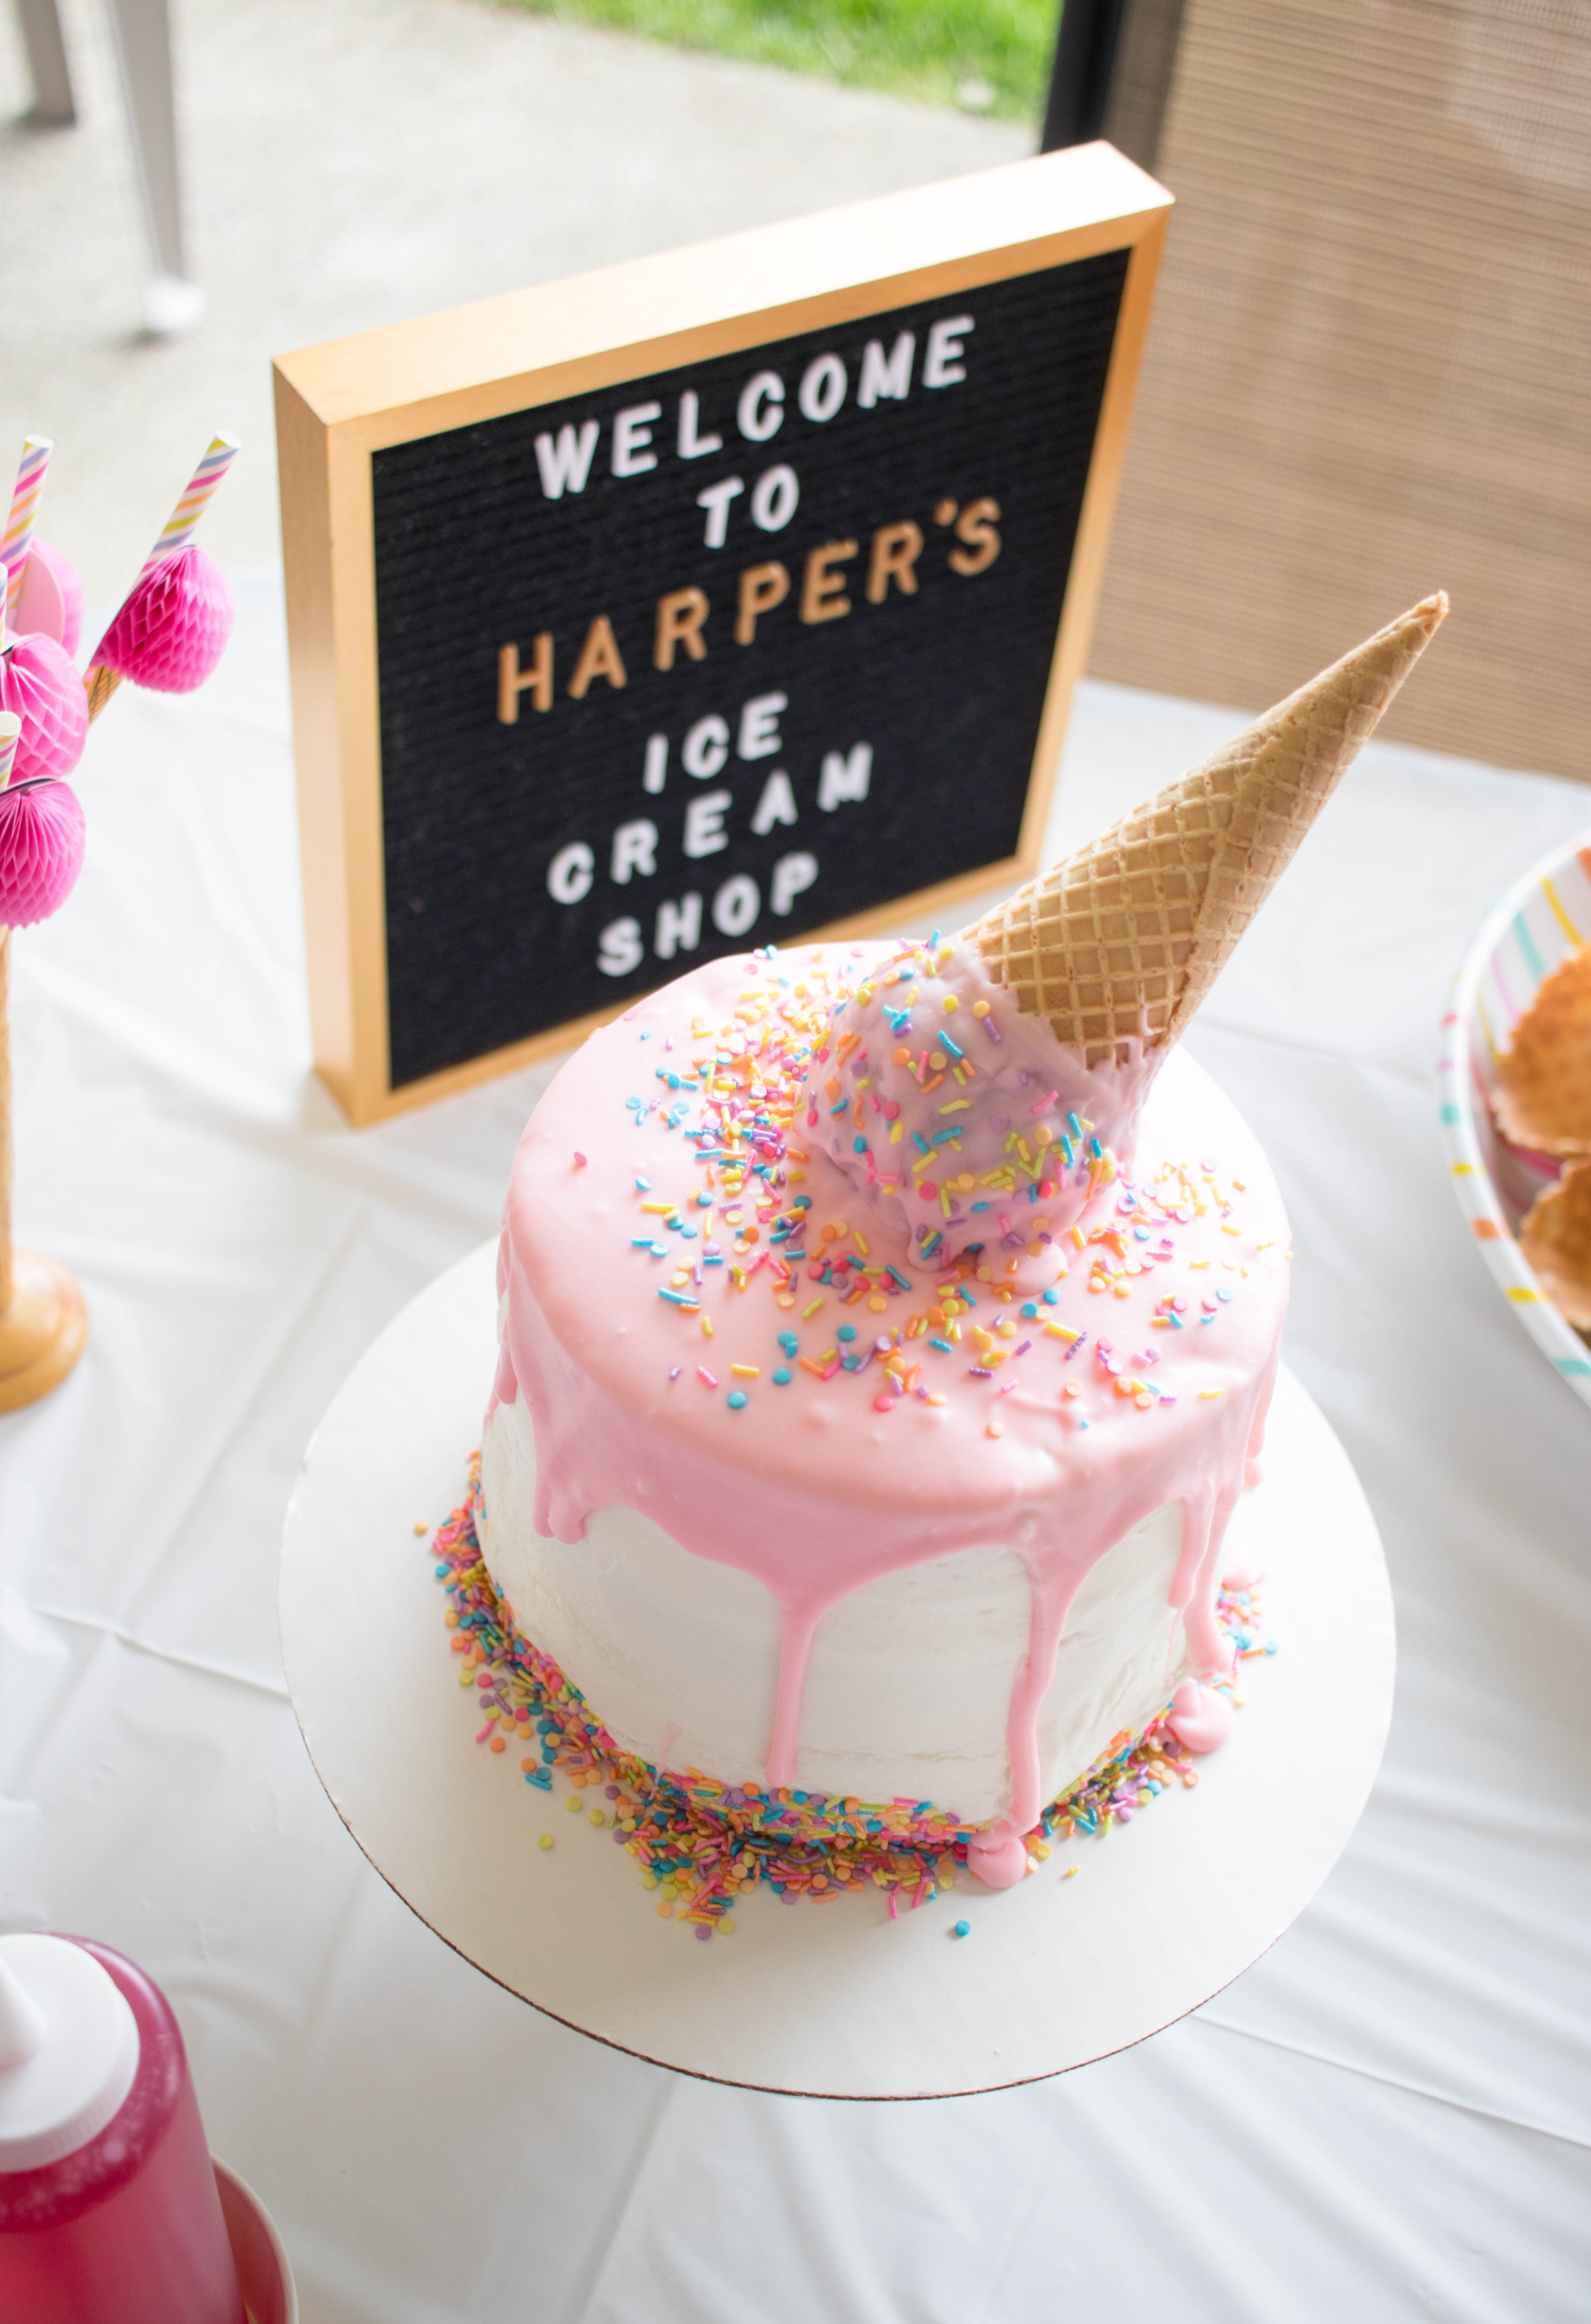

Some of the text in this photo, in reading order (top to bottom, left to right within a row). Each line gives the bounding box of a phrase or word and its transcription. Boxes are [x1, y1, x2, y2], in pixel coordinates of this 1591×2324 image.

[535, 316, 974, 500] WELCOME
[697, 465, 800, 549] TO
[497, 499, 1000, 724] HARPER'S
[643, 693, 788, 794] ICE
[547, 744, 872, 905] CREAM
[598, 853, 818, 977] SHOP
